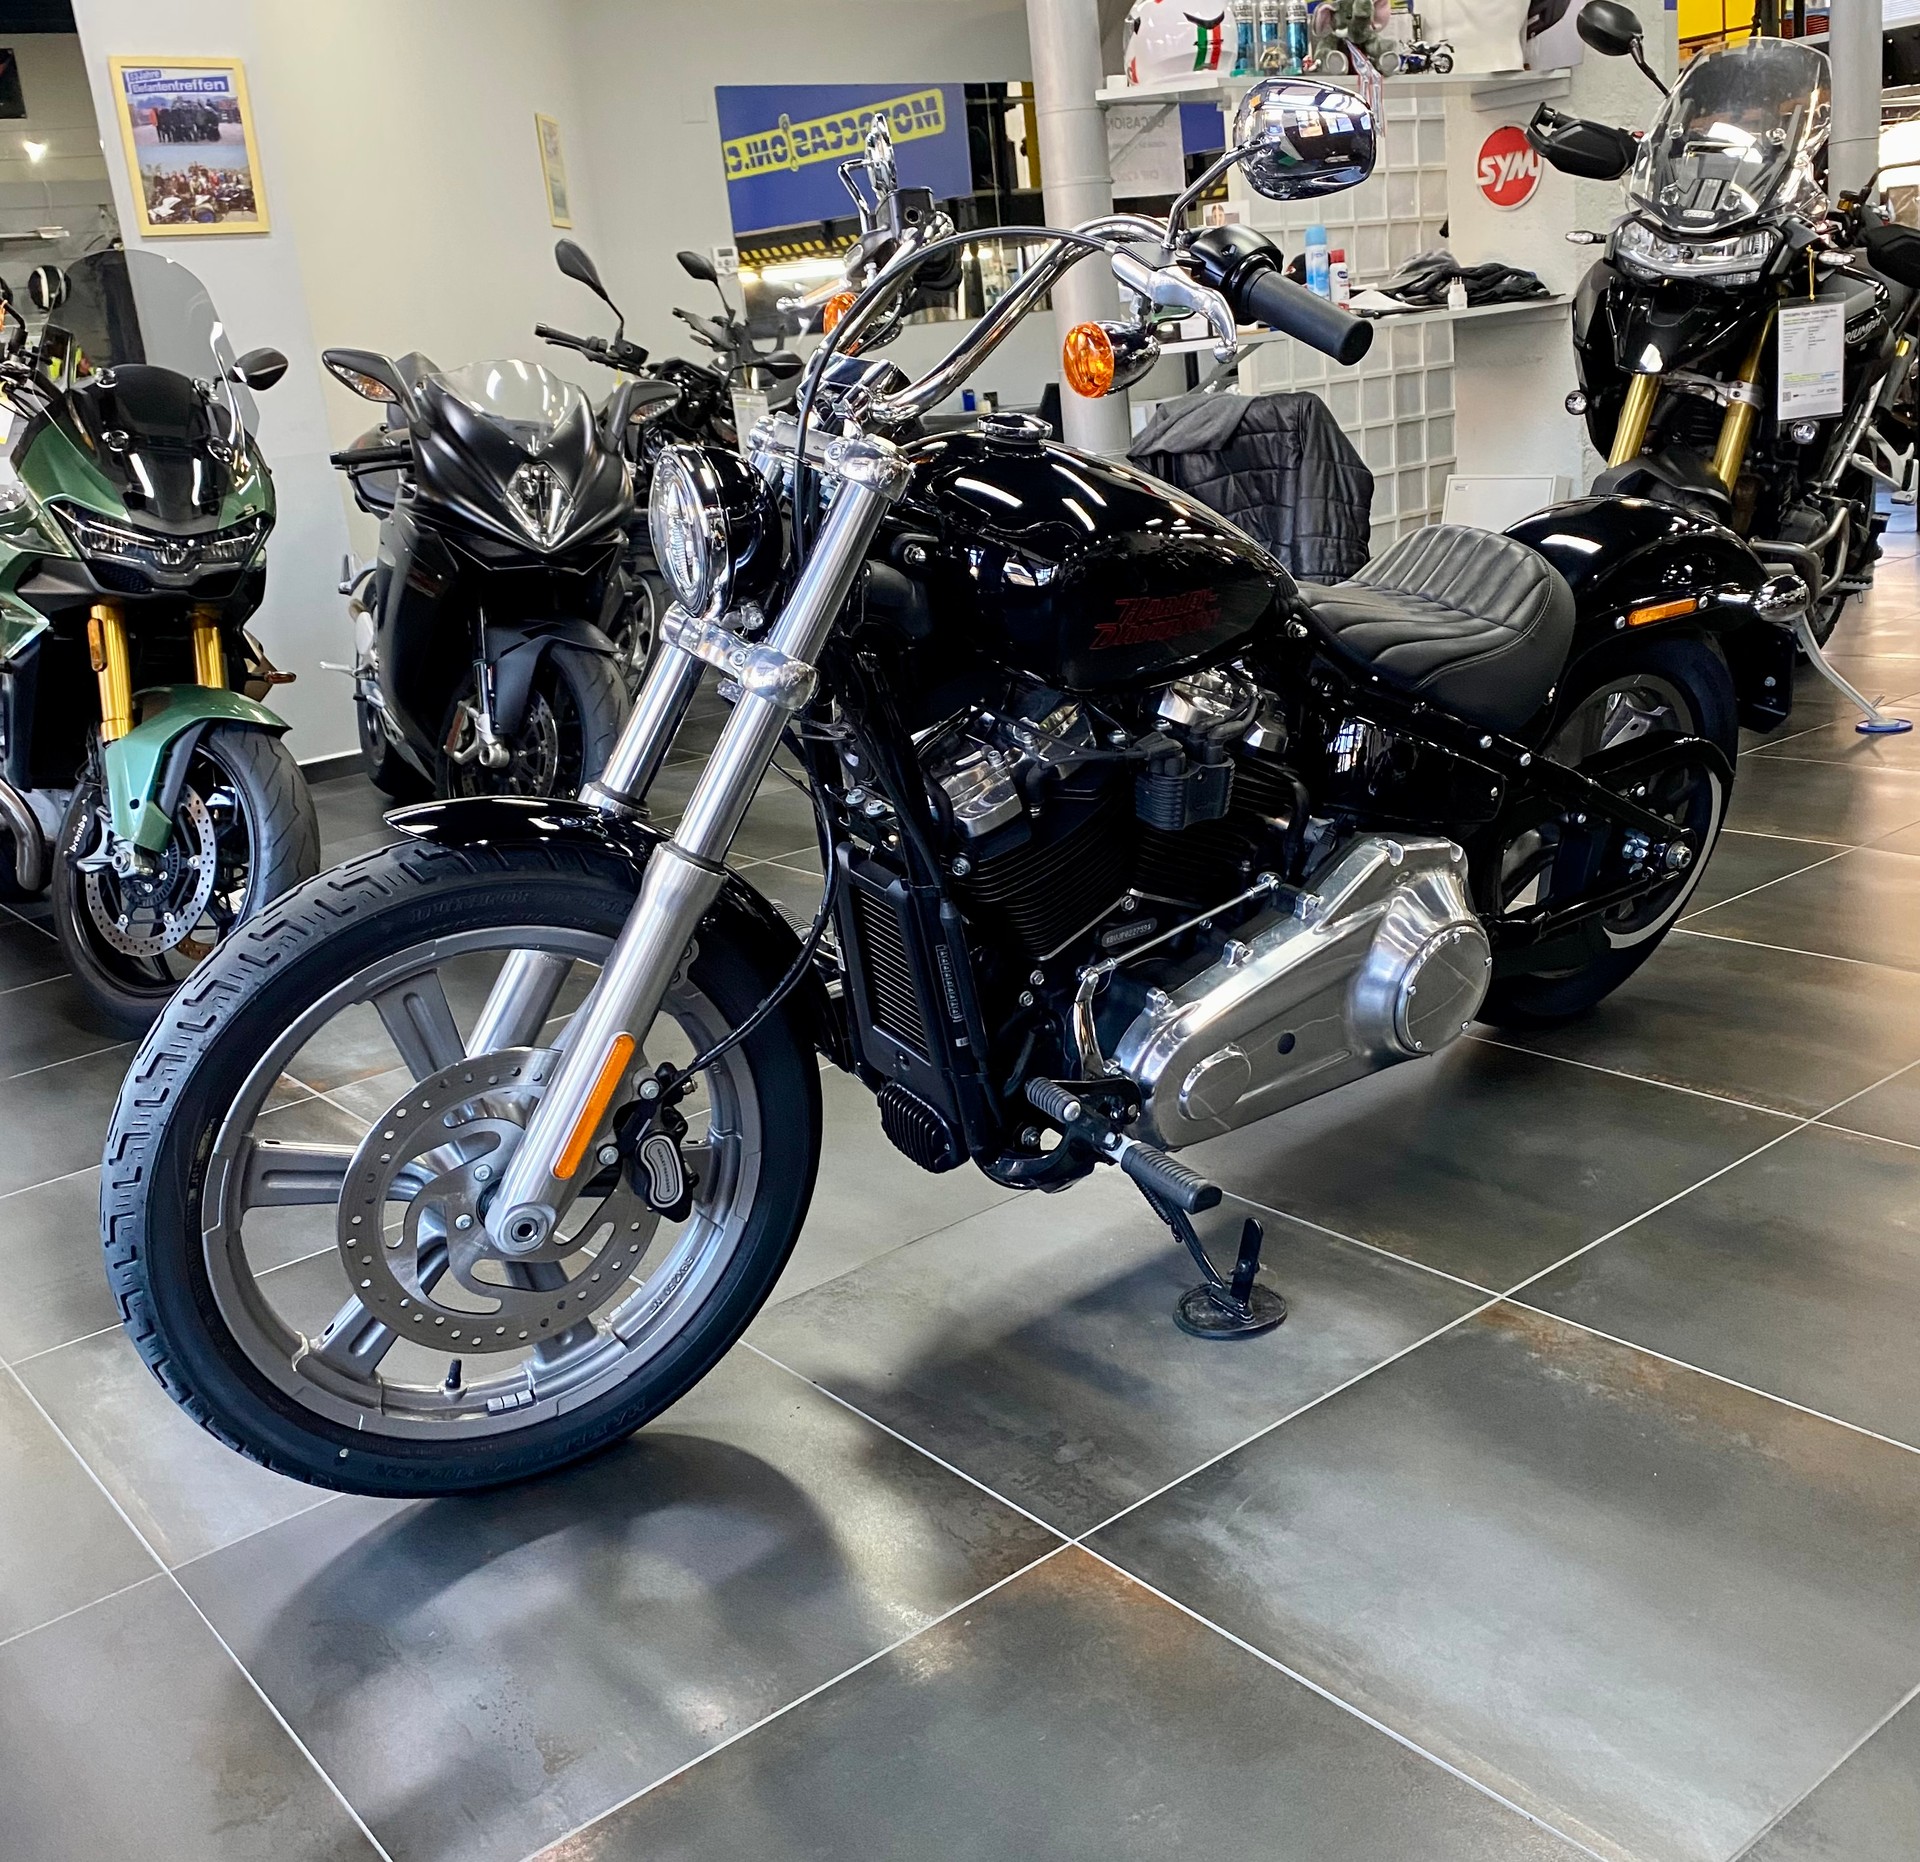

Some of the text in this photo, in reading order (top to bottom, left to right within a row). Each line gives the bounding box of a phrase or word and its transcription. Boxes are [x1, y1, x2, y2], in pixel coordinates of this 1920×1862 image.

[1478, 148, 1538, 192] SYM
[1845, 314, 1887, 344] RIUMPH
[69, 814, 88, 853] brembo
